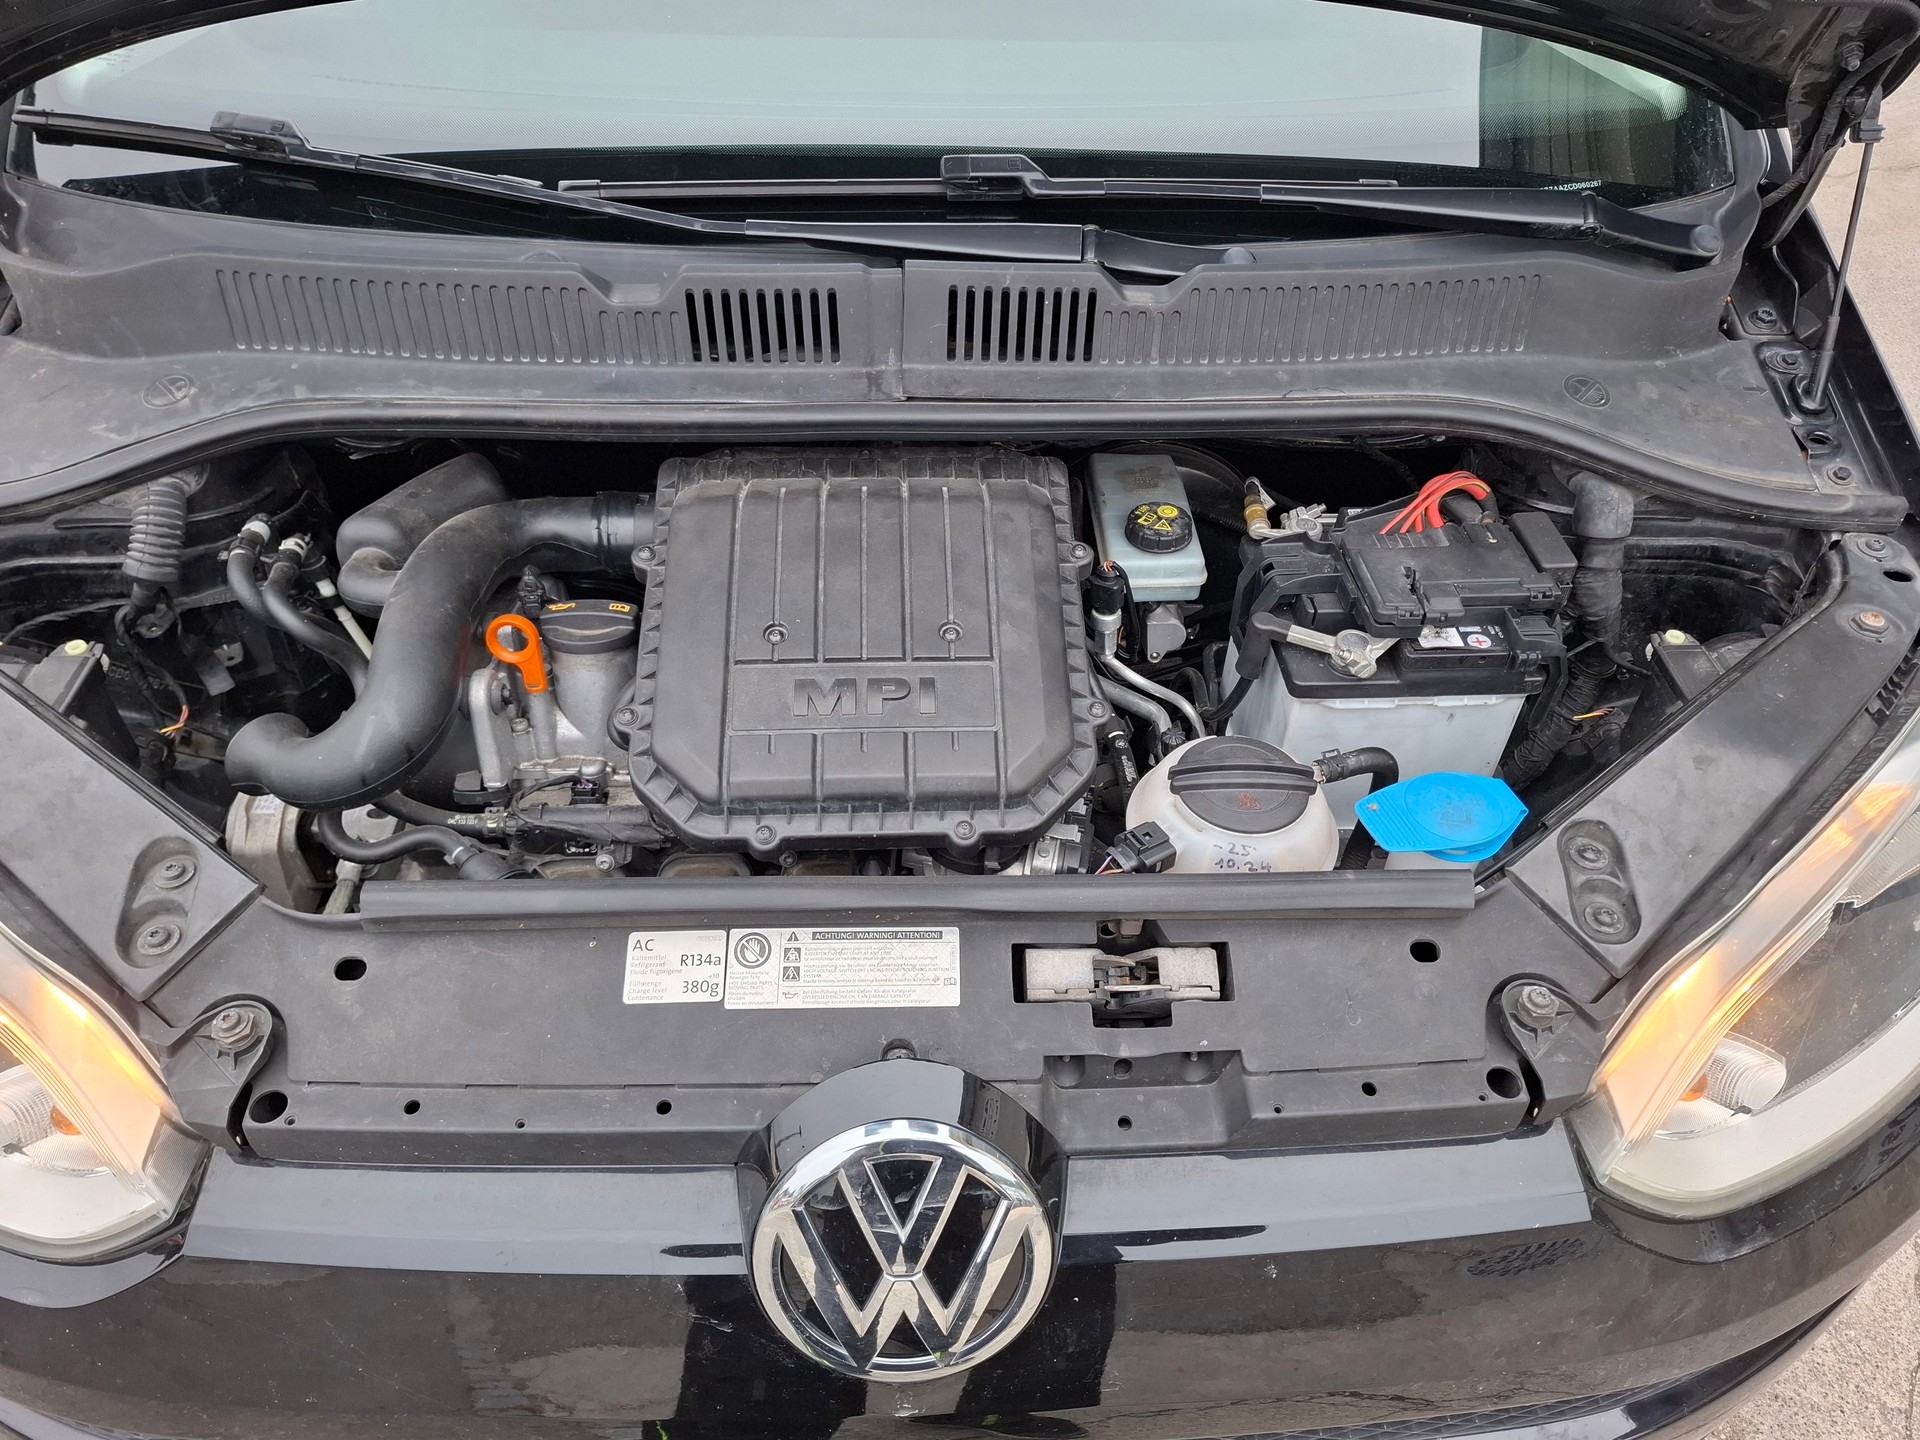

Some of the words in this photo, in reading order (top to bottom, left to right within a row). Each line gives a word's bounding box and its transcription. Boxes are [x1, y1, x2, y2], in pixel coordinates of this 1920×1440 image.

[793, 677, 936, 717] MPI
[897, 931, 940, 939] ATTENTION!
[632, 939, 654, 952] AC
[630, 961, 666, 969] Refrigerant
[680, 954, 721, 966] R134a
[682, 980, 719, 997] 380g
